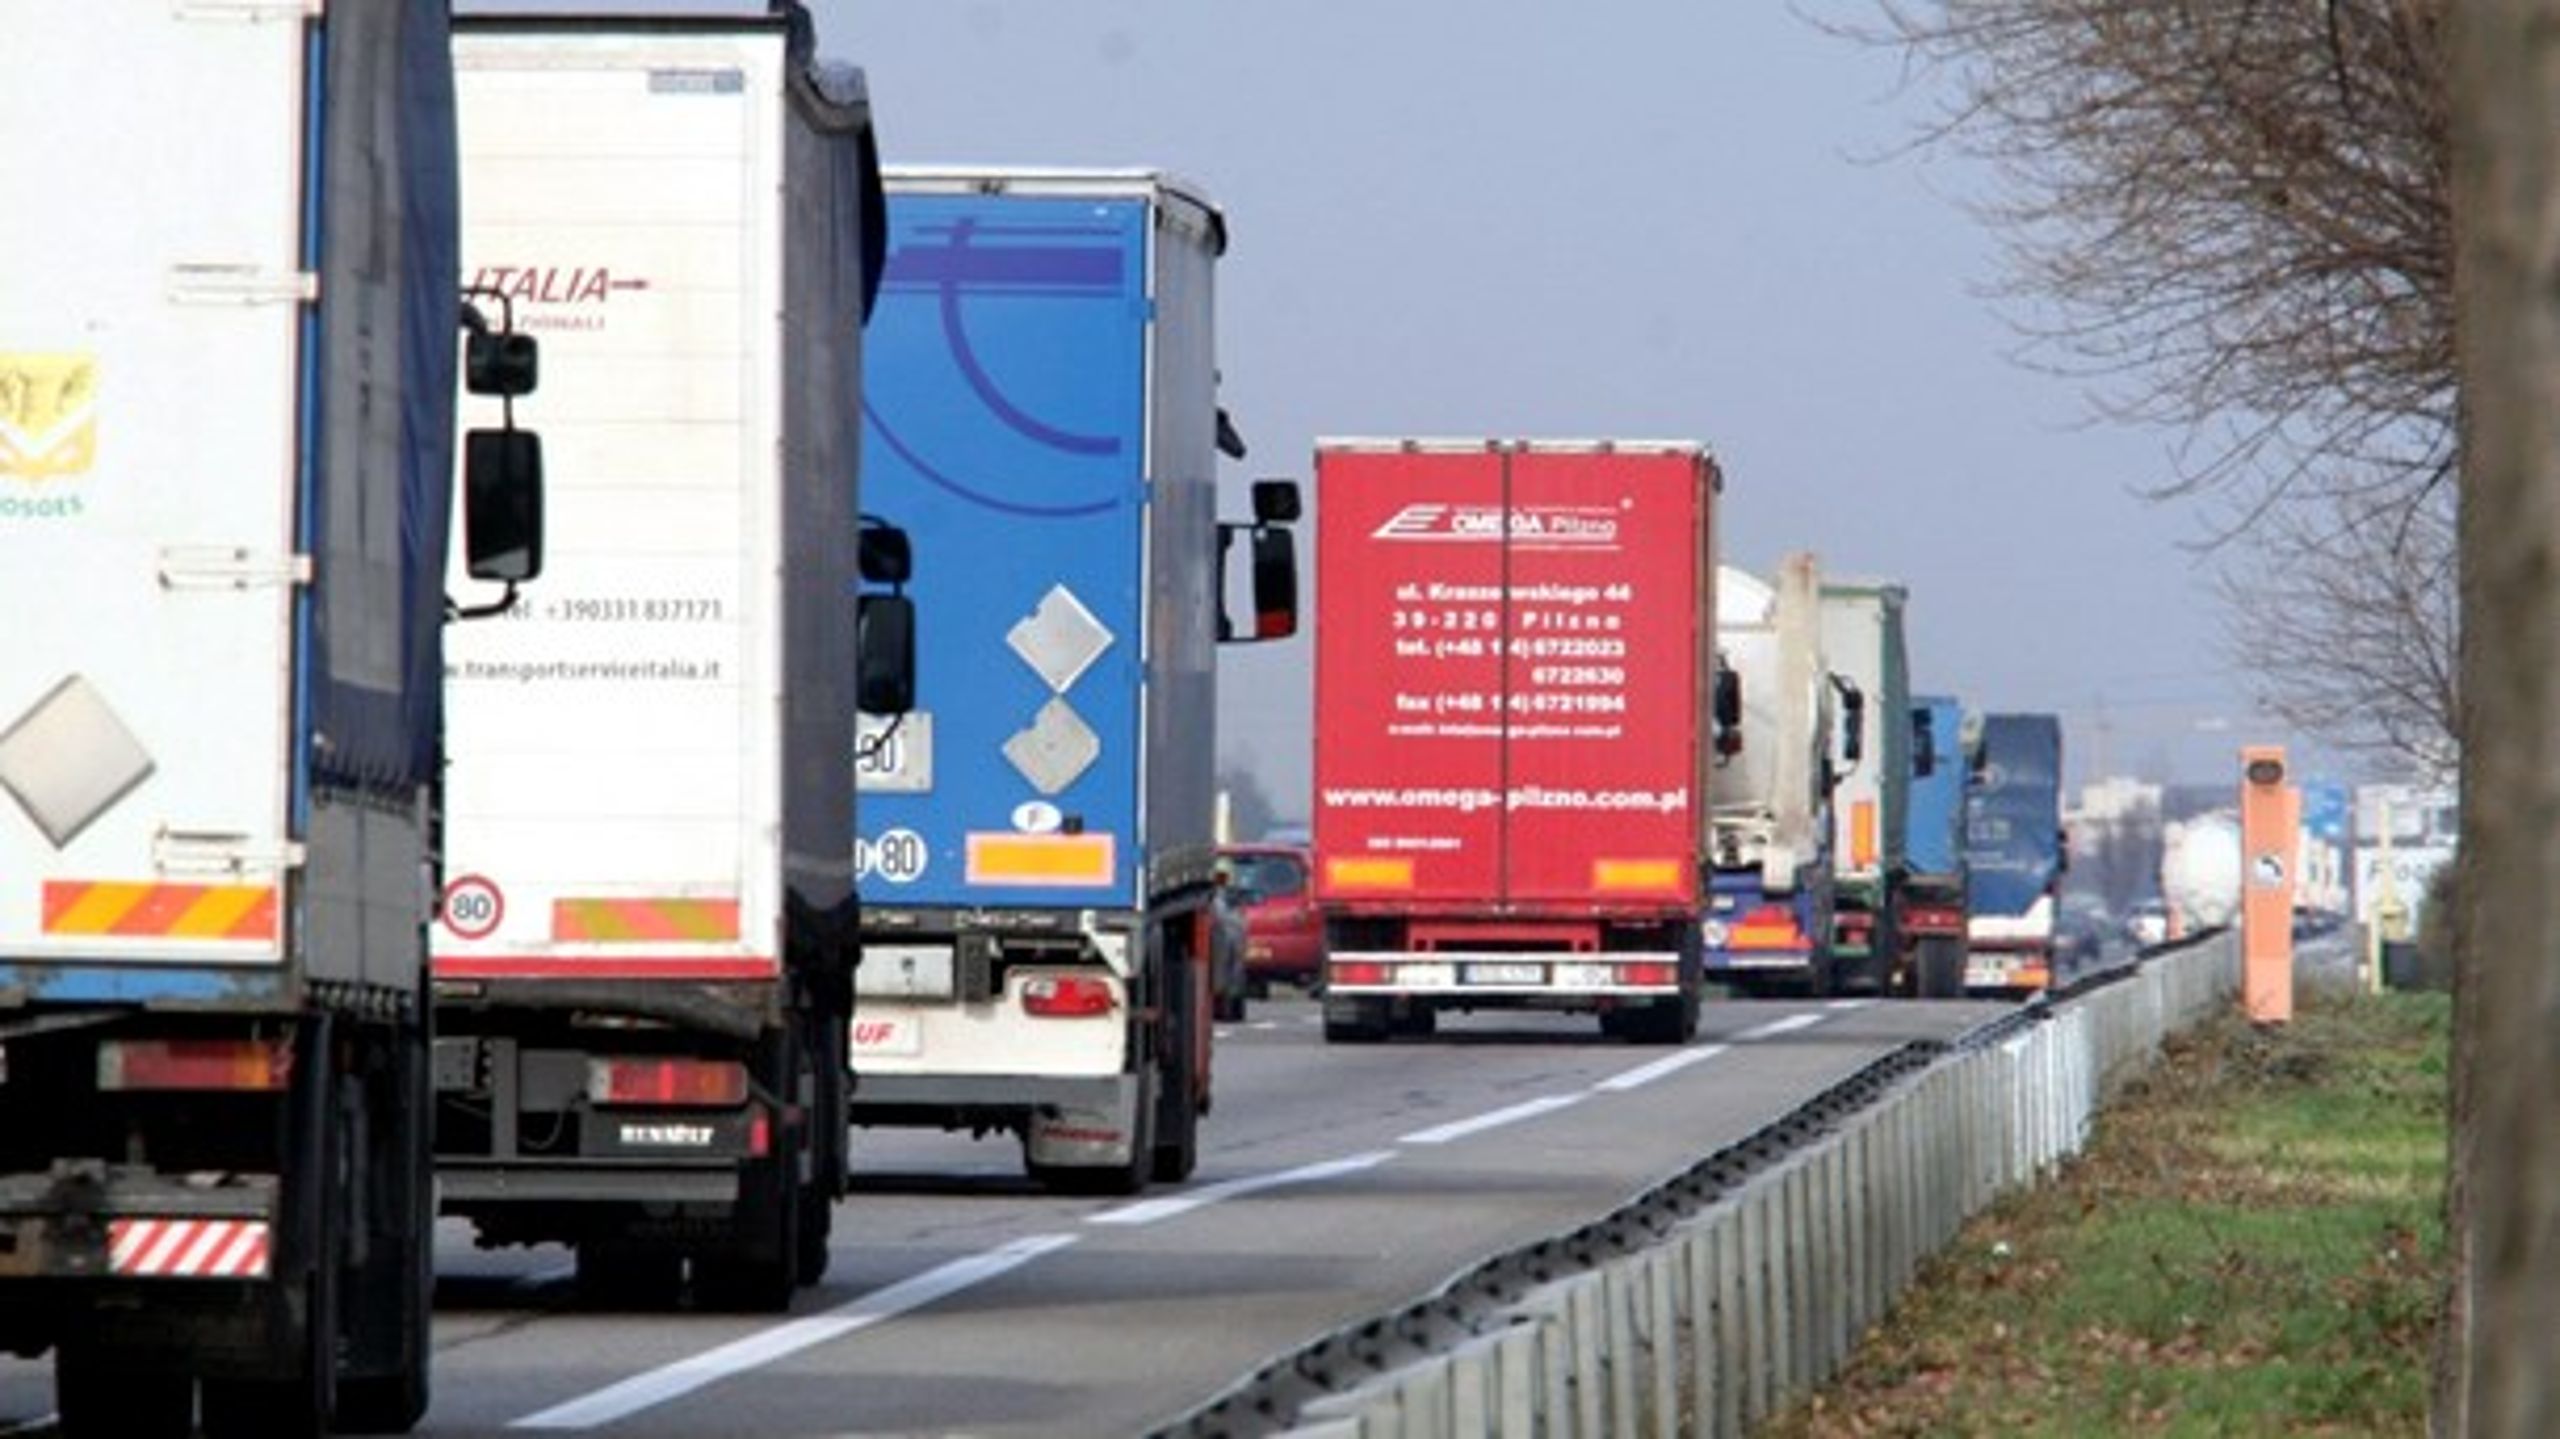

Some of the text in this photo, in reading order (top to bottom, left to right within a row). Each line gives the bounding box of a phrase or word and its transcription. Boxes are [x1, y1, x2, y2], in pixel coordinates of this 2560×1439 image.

[471, 267, 608, 302] ITALIA
[881, 834, 917, 874] 80
[453, 892, 491, 921] 80
